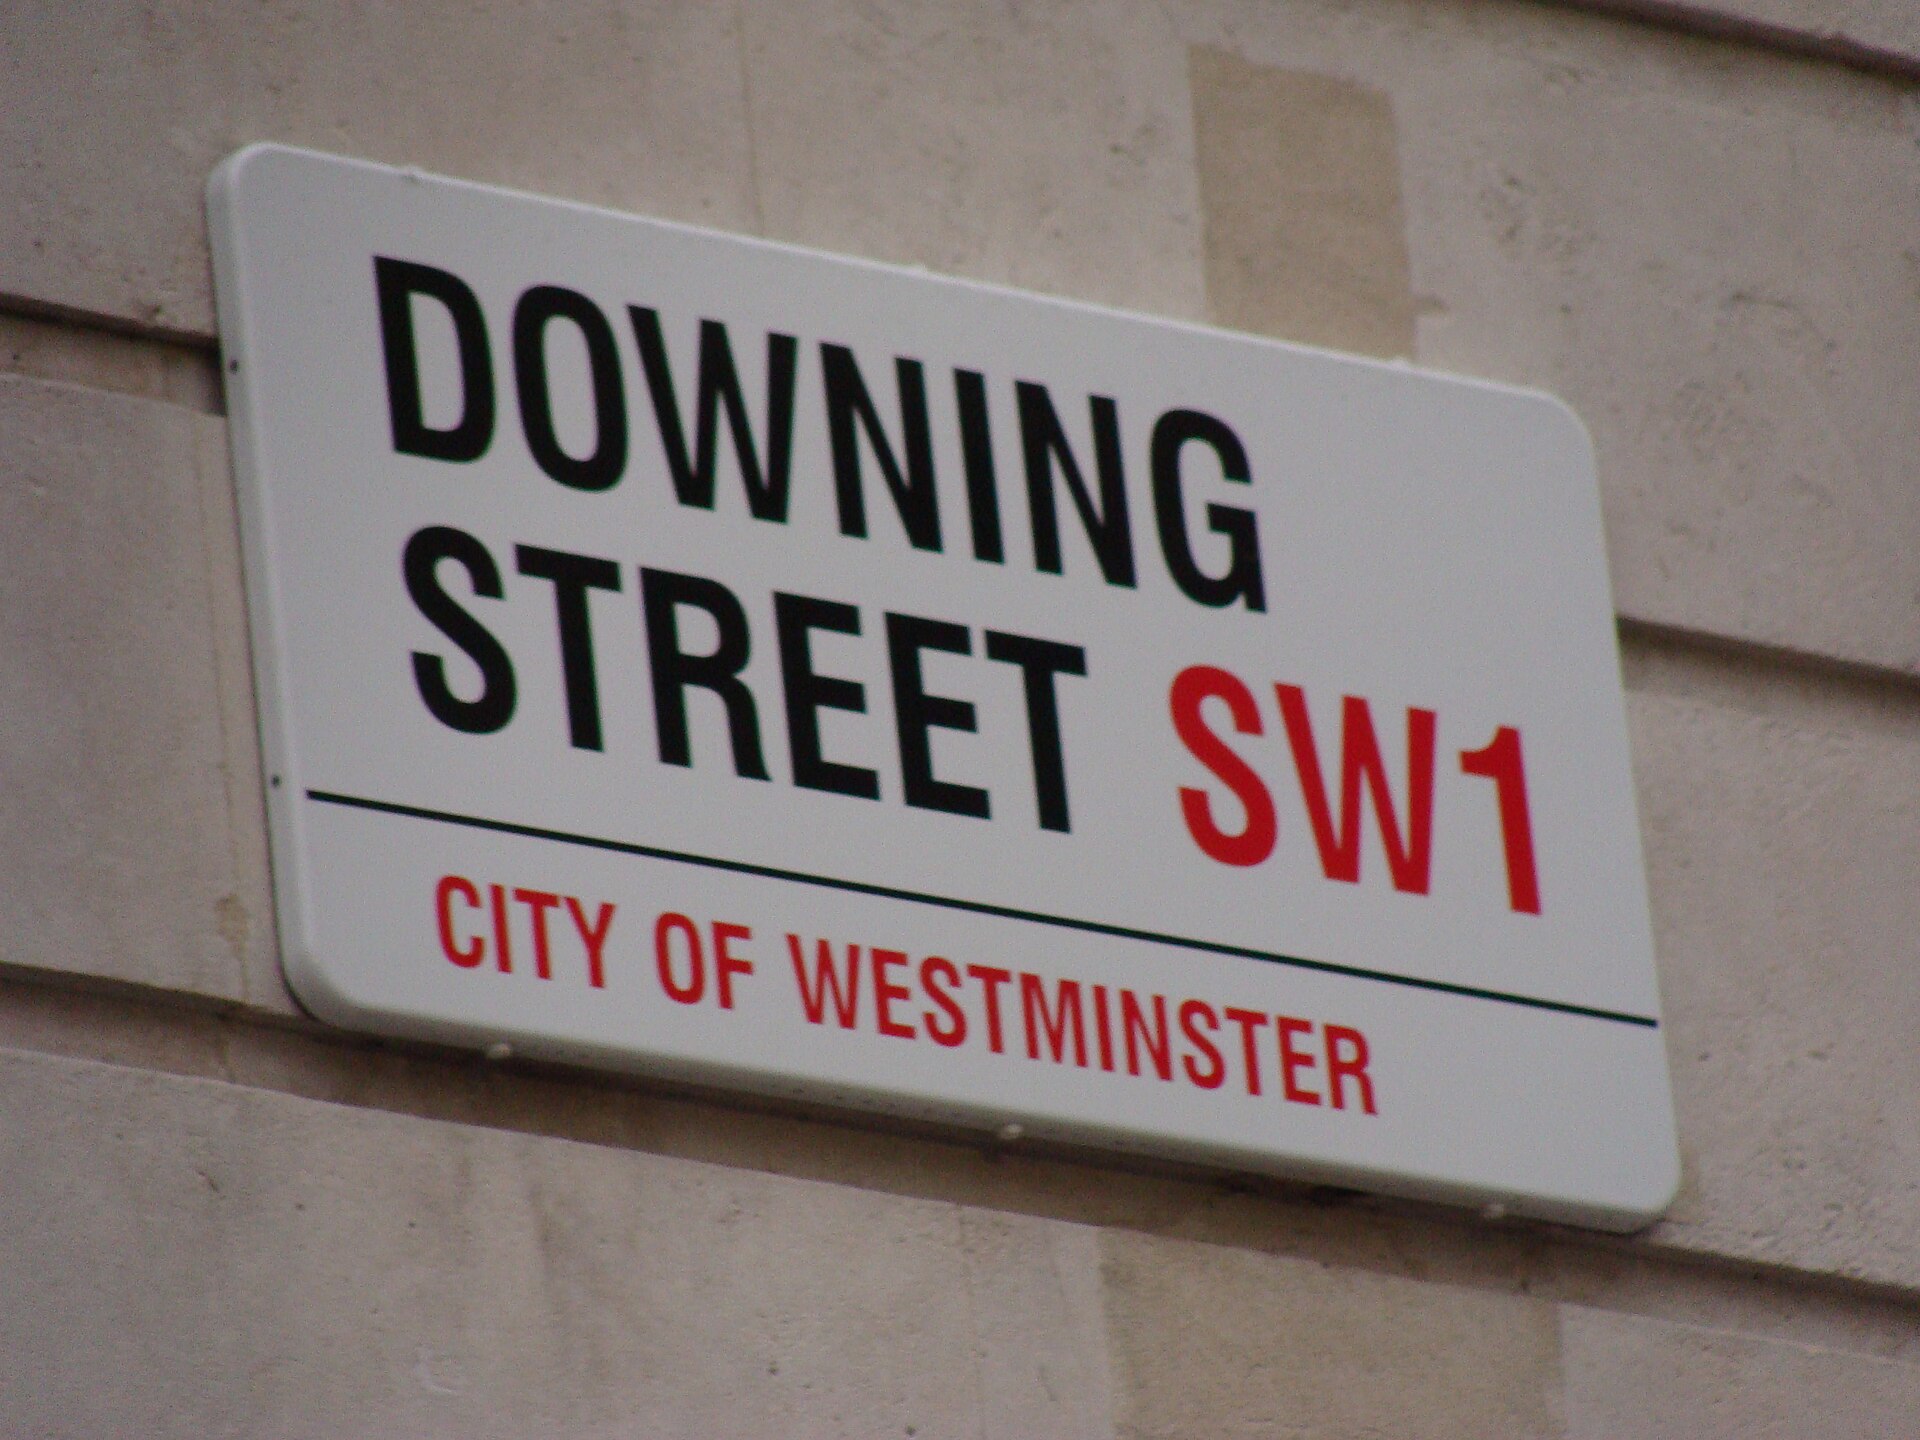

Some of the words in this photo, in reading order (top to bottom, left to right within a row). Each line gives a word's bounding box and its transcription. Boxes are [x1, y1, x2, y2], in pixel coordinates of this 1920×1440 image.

[372, 254, 1267, 614] DOWNING
[401, 524, 1088, 835] STREET
[1169, 664, 1542, 916] SW1
[435, 875, 615, 989] CITY
[654, 912, 753, 1010] OF
[786, 934, 1377, 1115] WESTMINSTER
